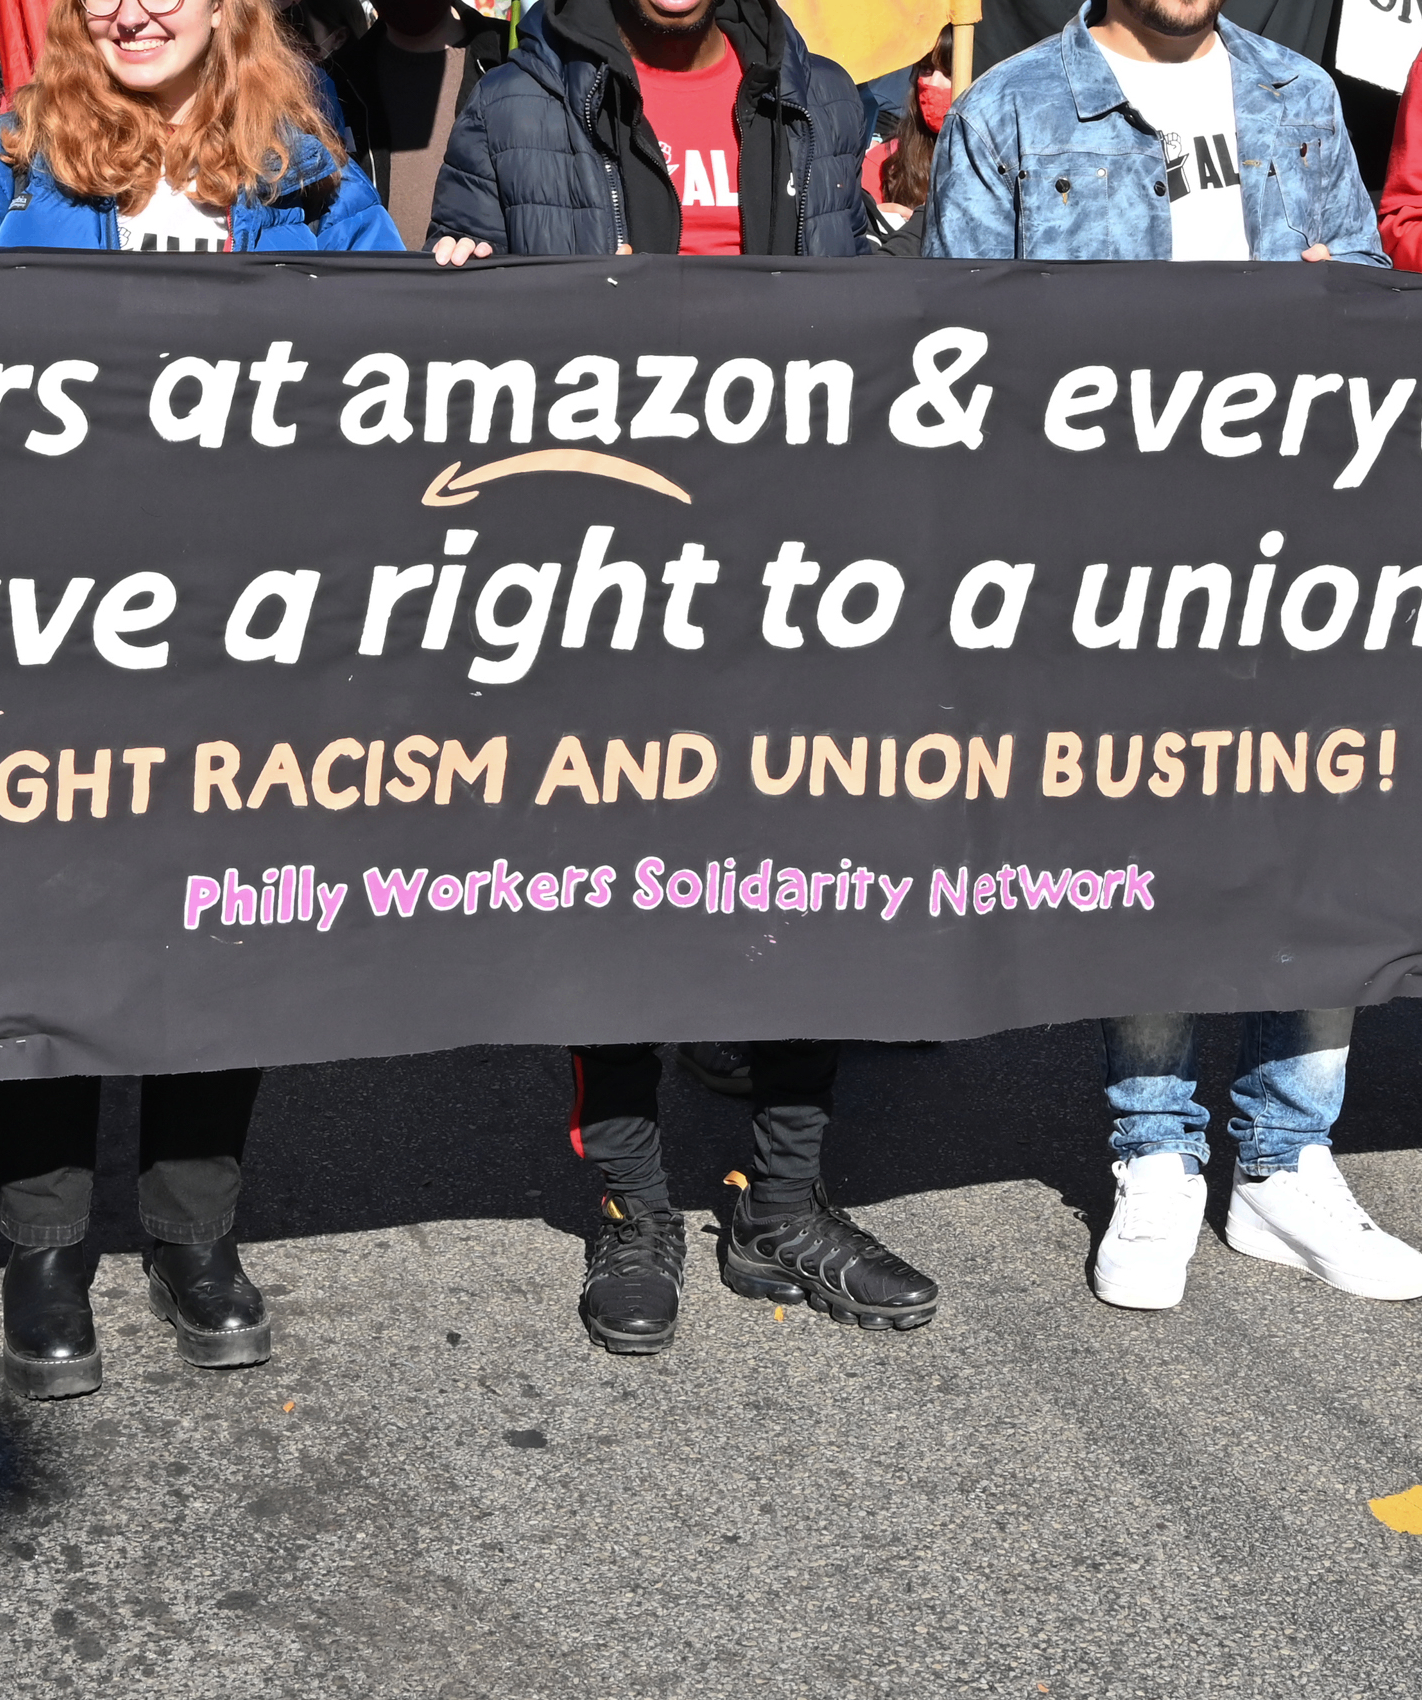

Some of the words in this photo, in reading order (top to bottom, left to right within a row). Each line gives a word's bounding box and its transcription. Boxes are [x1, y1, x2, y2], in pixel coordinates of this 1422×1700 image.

[682, 150, 739, 206] AL
[1193, 133, 1240, 190] AL
[149, 341, 308, 448] at
[340, 353, 853, 445] amazon
[889, 327, 993, 450] &
[225, 570, 320, 664] a
[358, 526, 720, 684] right
[762, 541, 905, 649] to
[950, 560, 1035, 649] a
[194, 735, 507, 813] RACISM
[535, 733, 717, 805] AND
[751, 733, 1013, 800] UNION
[1043, 729, 1396, 797] BUSTING!
[184, 865, 348, 931] Philly
[363, 859, 616, 917] Workers
[633, 856, 913, 920] Solidarity
[929, 864, 1154, 917] Network
